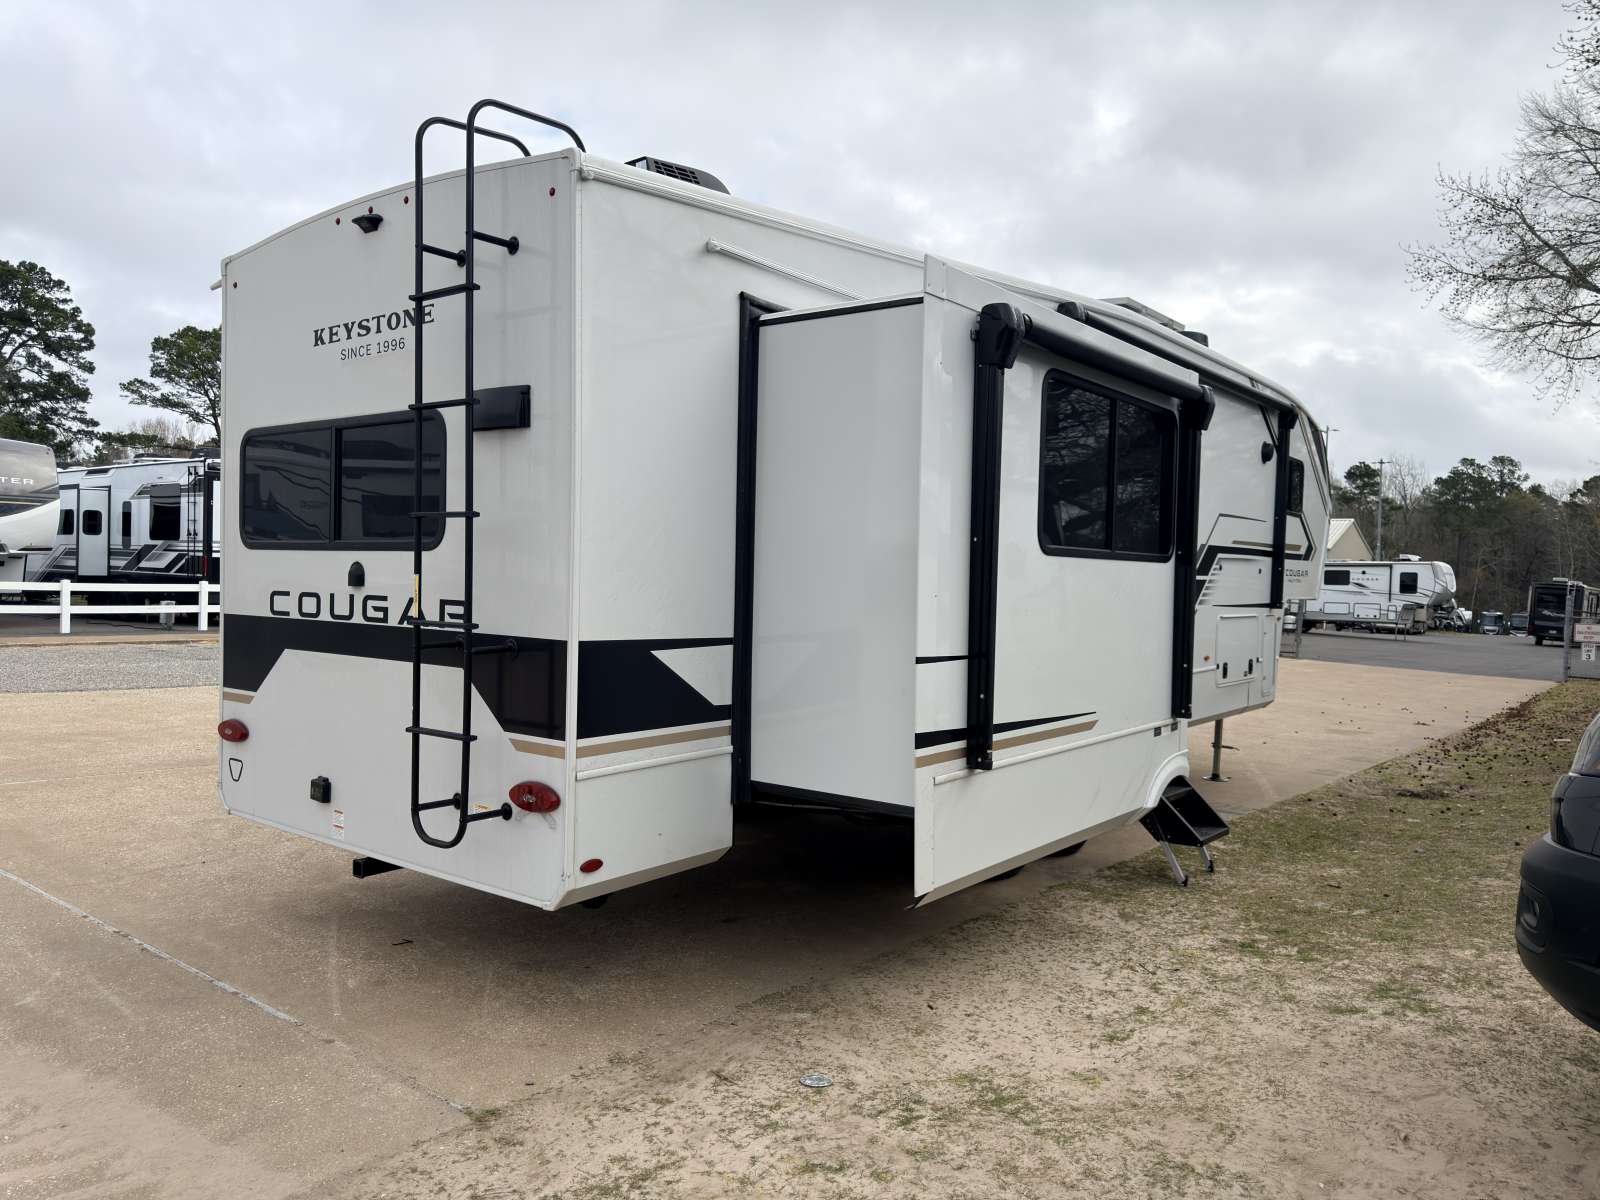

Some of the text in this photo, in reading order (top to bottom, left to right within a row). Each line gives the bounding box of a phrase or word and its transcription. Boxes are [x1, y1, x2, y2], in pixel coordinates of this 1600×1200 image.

[313, 303, 435, 347] KEYSTONE
[340, 337, 406, 361] SINCE 1996
